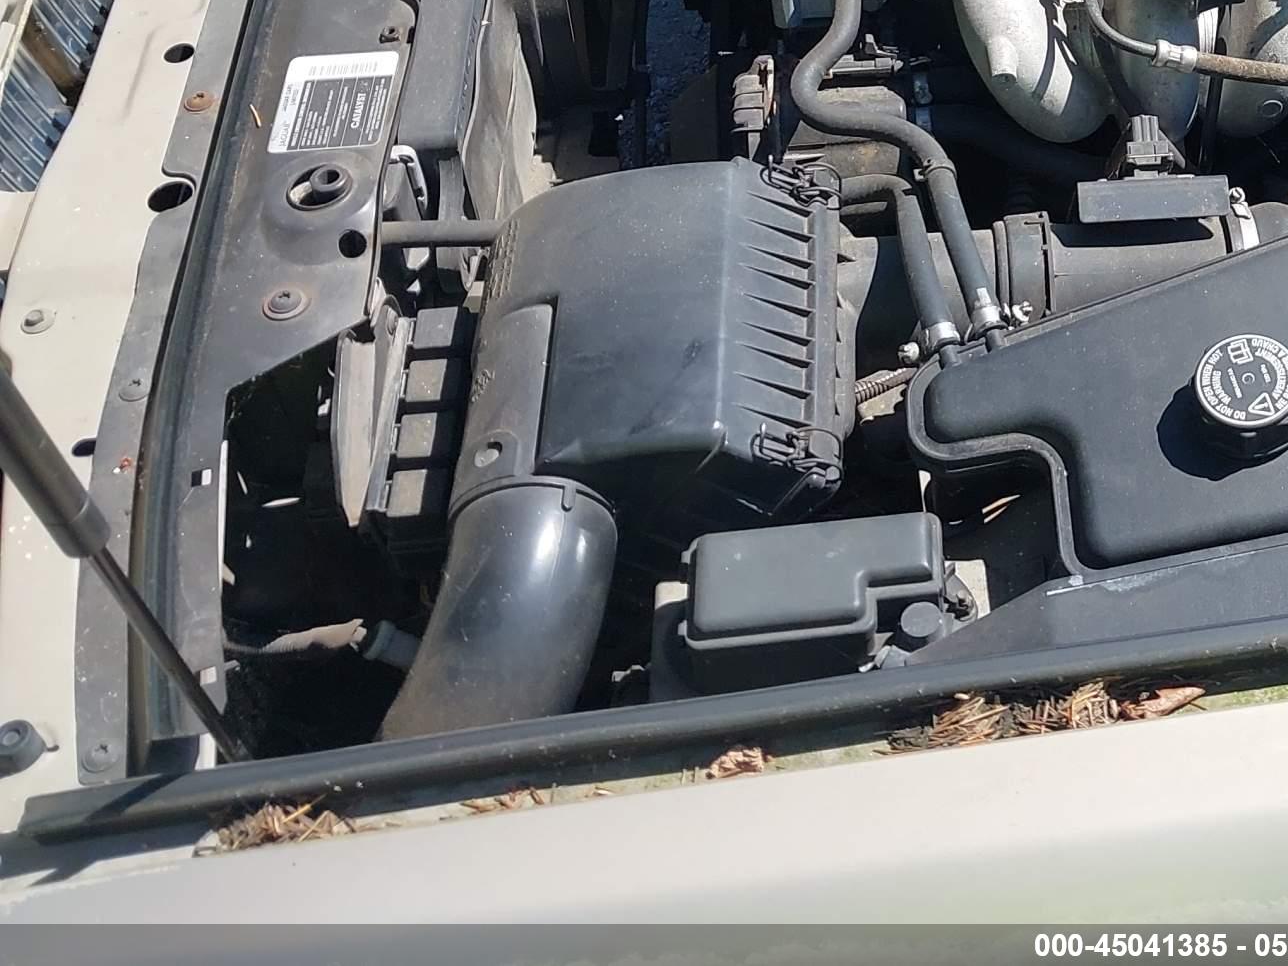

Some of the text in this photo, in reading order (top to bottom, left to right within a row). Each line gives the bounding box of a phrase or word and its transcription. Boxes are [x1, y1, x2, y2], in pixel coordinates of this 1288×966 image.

[350, 92, 367, 129] CATALYST
[1251, 338, 1280, 354] CHAUD
[1207, 349, 1223, 365] HOT
[1201, 362, 1212, 386] WHEN
[1202, 386, 1220, 406] OPEN
[1211, 369, 1232, 405] WARNING
[1215, 402, 1234, 416] NOT
[1233, 410, 1246, 420] DO
